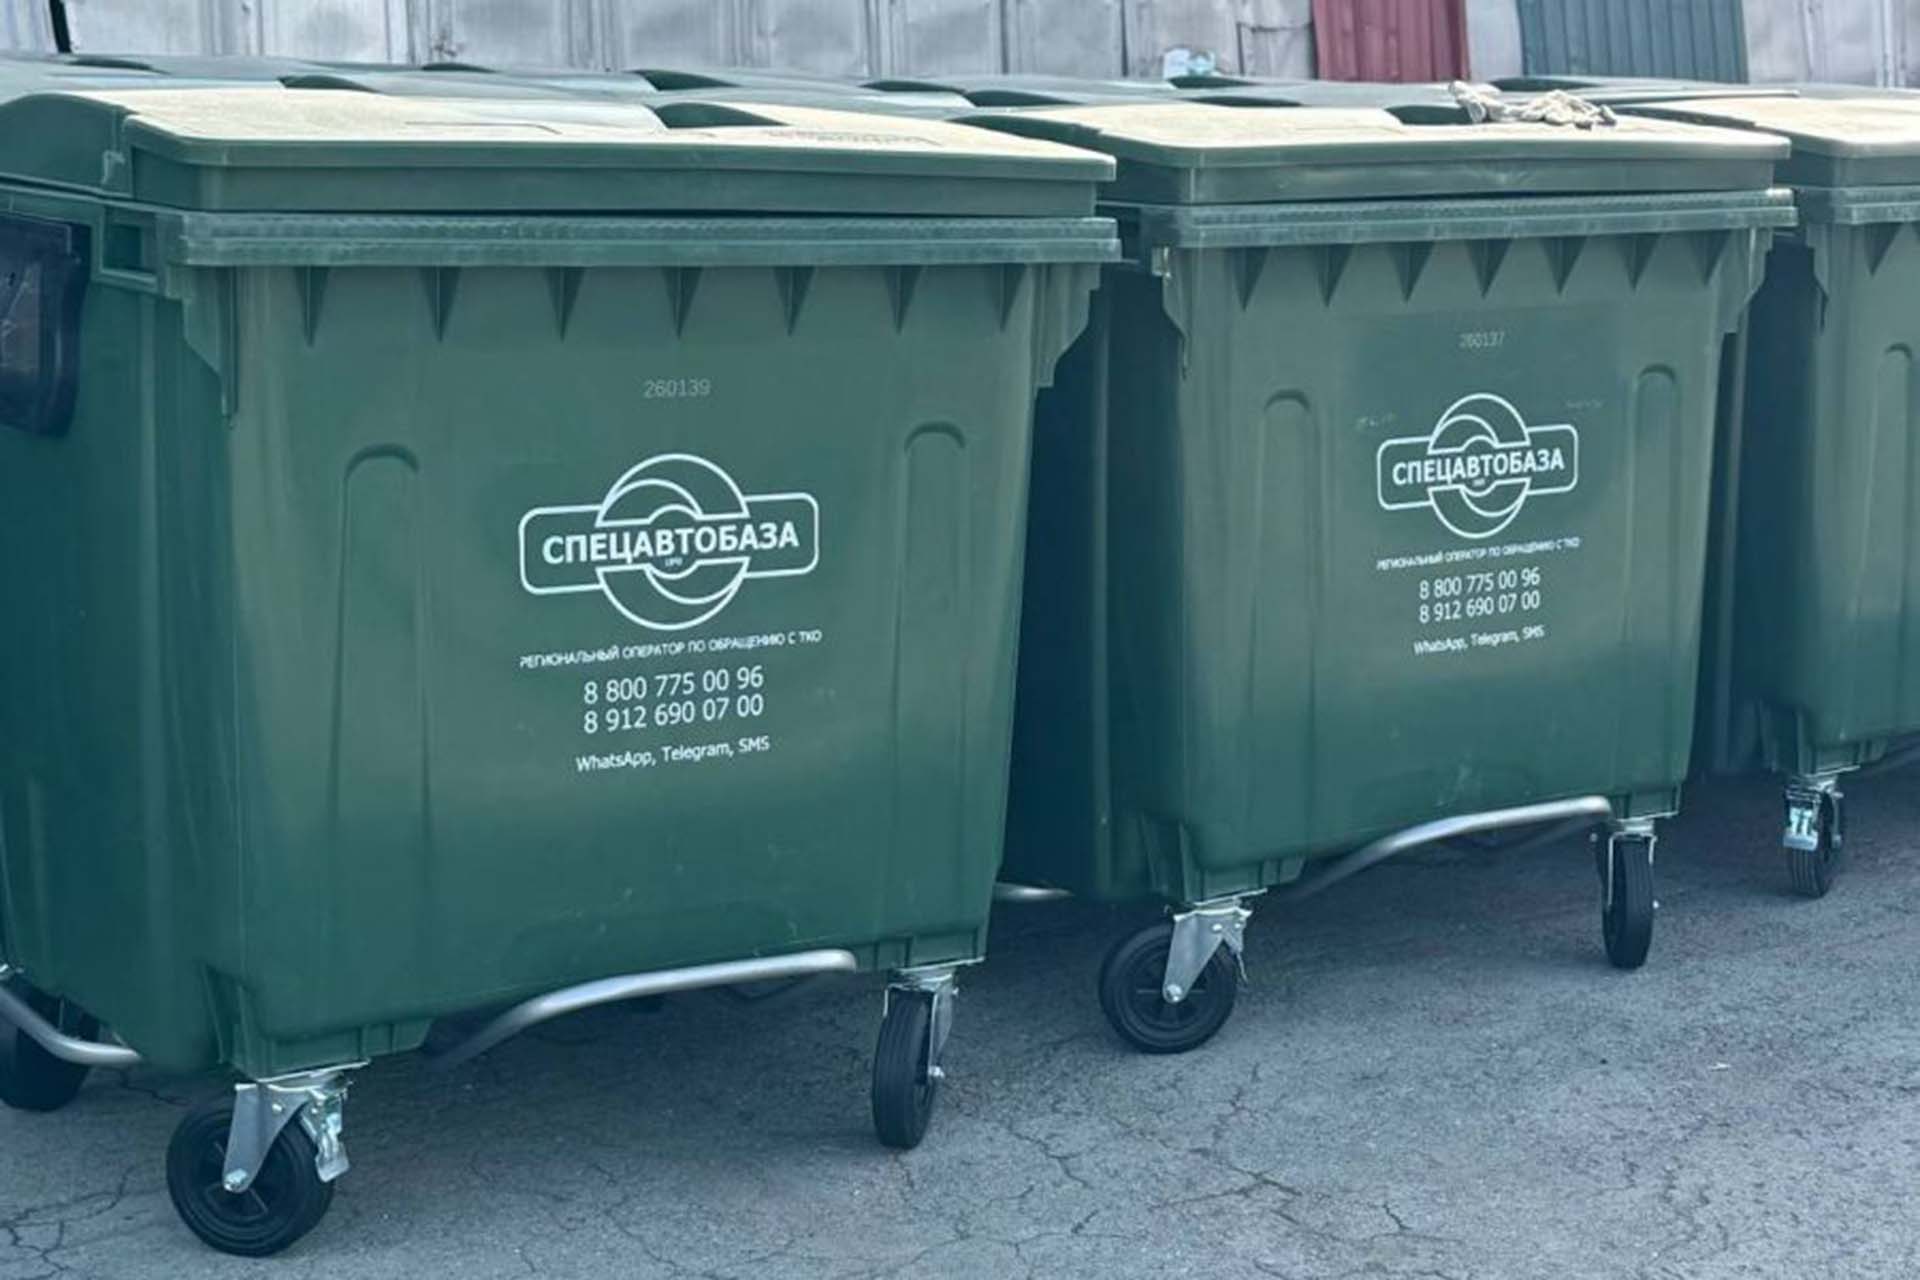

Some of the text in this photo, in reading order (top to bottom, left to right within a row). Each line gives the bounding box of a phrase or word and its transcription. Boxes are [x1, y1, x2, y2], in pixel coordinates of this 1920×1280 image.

[643, 379, 711, 399] 260139
[1392, 448, 1565, 486] СПЕЦАВТОБАЗА
[542, 521, 800, 565] СПЕЦАВТОБАЗА
[1419, 566, 1541, 600] 8 800 775 00 96
[1419, 589, 1540, 624] 8 912 690 07 00
[622, 641, 685, 660] ОПЕРАТОР
[688, 638, 706, 653] ПО
[788, 631, 797, 645] С
[799, 629, 823, 643] ТКО
[1522, 624, 1545, 640] SMS
[584, 665, 764, 704] 8 800 775 00 96
[584, 693, 763, 734] 8 912 690 07 00
[576, 735, 770, 772] WhatsApp, Telegram, SMS
